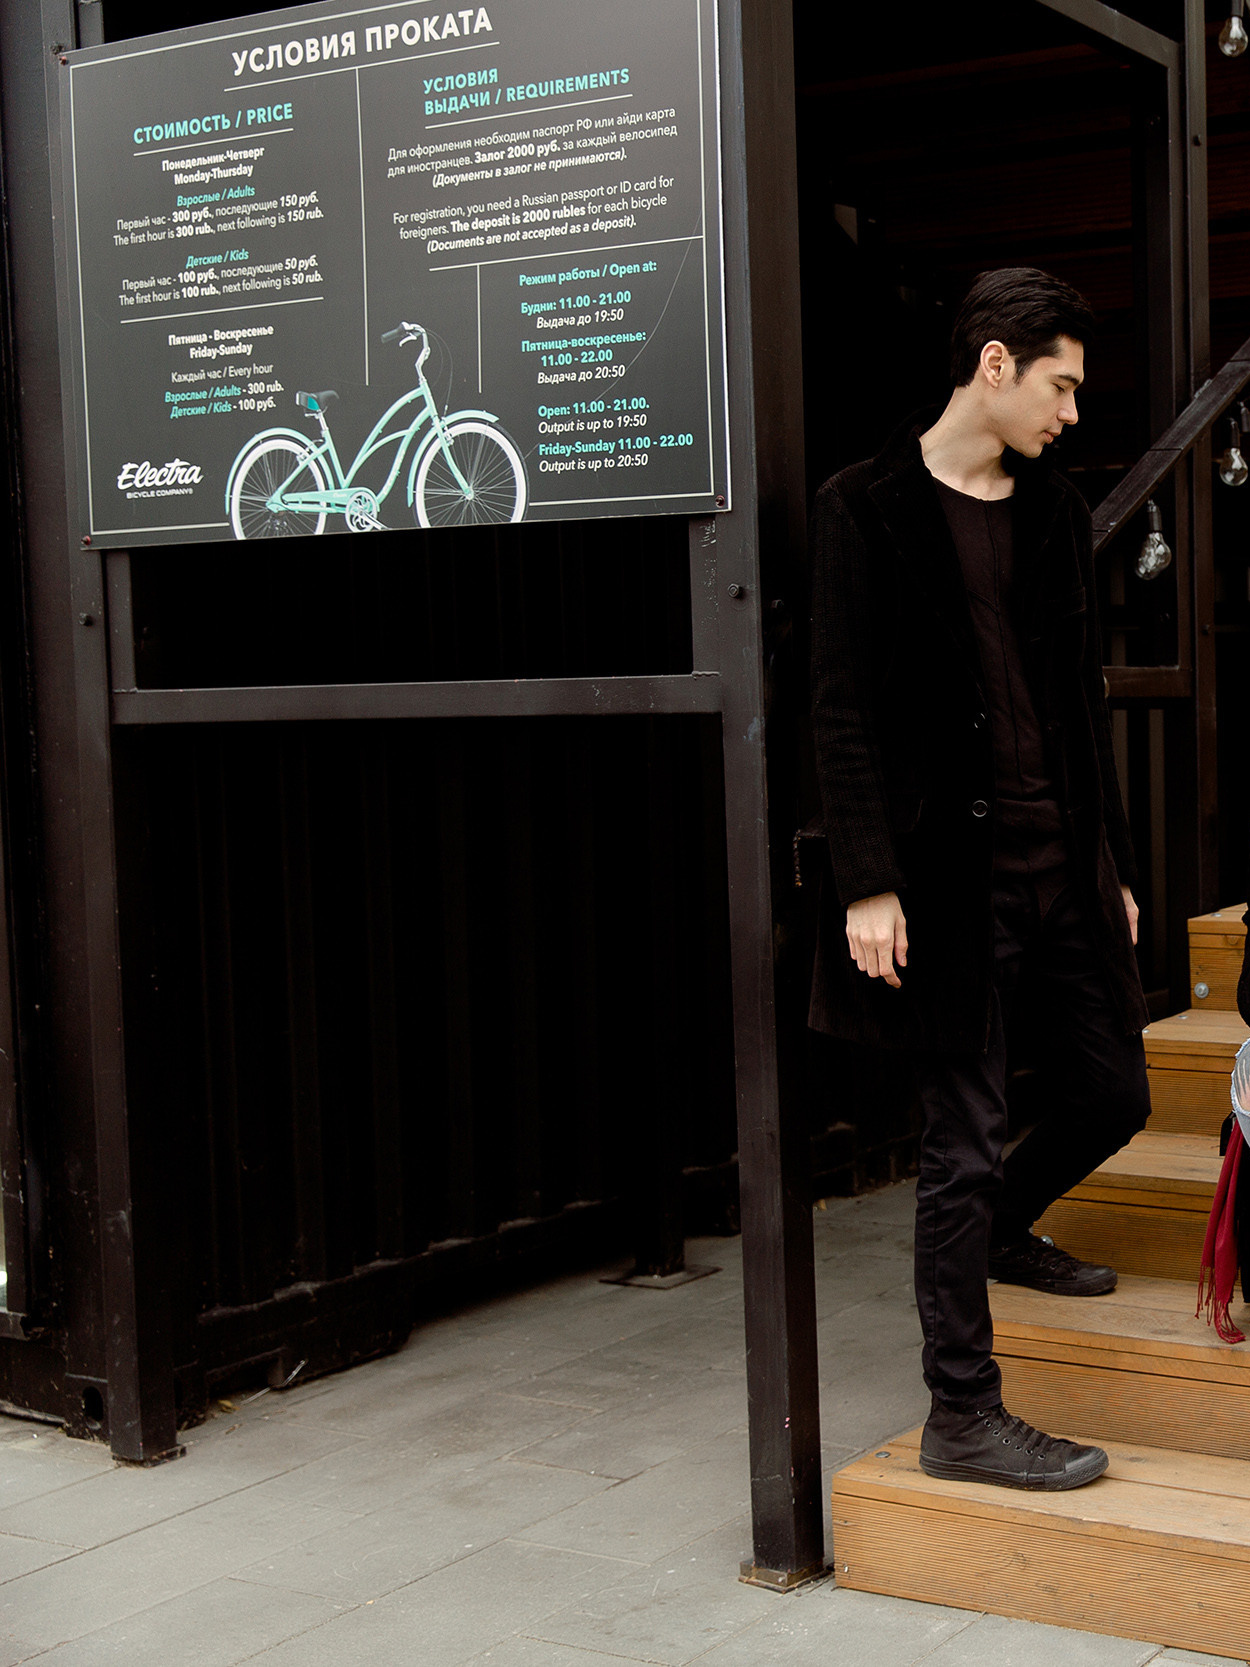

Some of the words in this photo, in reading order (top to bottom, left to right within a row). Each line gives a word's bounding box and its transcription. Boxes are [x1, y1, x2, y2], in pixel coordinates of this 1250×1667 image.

[231, 30, 356, 76] УСЛОВИЯ
[365, 7, 492, 52] ПРОКАТА
[423, 68, 498, 94] УСЛОВИЯ
[424, 91, 490, 115] ВЫДАЧИ
[495, 88, 501, 104] /
[506, 68, 629, 102] REQUIREMENTS
[133, 113, 230, 144] СТОИМОСТЬ
[235, 110, 242, 128] /
[246, 102, 293, 125] PRICE
[387, 148, 407, 162] Для
[409, 139, 472, 158] оформления
[474, 130, 530, 147] необходим
[532, 123, 574, 138] паспорт
[576, 118, 592, 131] РФ
[594, 117, 614, 128] или
[616, 112, 643, 125] айди
[645, 108, 675, 122] карта
[161, 147, 264, 171] Понедельник-Четверг
[387, 166, 405, 178] для
[407, 156, 473, 173] иностранцев.
[474, 150, 506, 163] Залог
[507, 143, 535, 158] 2000
[536, 139, 560, 157] руб.
[562, 140, 574, 150] за
[576, 131, 616, 148] каждый
[619, 125, 678, 142] велосипед
[174, 163, 253, 185] Monday-Thursday
[432, 169, 493, 188] (Документы
[495, 168, 502, 177] в
[503, 163, 532, 176] залог
[533, 161, 547, 171] не
[548, 146, 627, 172] принимаются).
[176, 192, 220, 208] Взрослые
[226, 184, 255, 199] Adults
[393, 212, 409, 224] For
[410, 205, 465, 224] registration,
[466, 204, 484, 217] you
[486, 196, 512, 211] need
[513, 198, 520, 208] a
[522, 192, 558, 206] Russian
[560, 185, 604, 204] passport
[606, 185, 618, 195] or
[620, 180, 632, 193] ID
[633, 176, 656, 191] card
[658, 174, 674, 188] for
[116, 216, 150, 232] Первый
[151, 216, 166, 225] час
[172, 209, 190, 223] 300
[215, 200, 278, 216] последующие
[280, 193, 298, 207] 150
[298, 190, 319, 208] руб.
[399, 225, 449, 240] foreigners.
[450, 219, 470, 232] The
[471, 213, 510, 232] deposit
[511, 212, 521, 224] is
[522, 208, 550, 223] 2000
[552, 204, 586, 219] rubles
[587, 201, 602, 214] for
[604, 197, 628, 212] each
[630, 193, 667, 210] bicycle
[113, 234, 129, 246] The
[130, 232, 146, 243] first
[146, 230, 166, 241] hour
[167, 228, 174, 238] is
[175, 224, 194, 238] 300
[217, 220, 236, 232] next
[236, 214, 276, 229] following
[278, 212, 285, 223] is
[287, 208, 305, 222] 150
[306, 206, 324, 219] rub.
[427, 235, 484, 254] (Documents
[485, 234, 502, 244] are
[503, 230, 520, 242] not
[521, 222, 568, 240] accepted
[569, 224, 581, 234] as
[582, 223, 589, 232] a
[591, 214, 636, 233] deposit).
[185, 254, 223, 269] Детские
[229, 248, 249, 261] Kids
[122, 276, 155, 292] Первый
[156, 276, 172, 286] час
[177, 270, 196, 283] 100
[220, 262, 283, 278] последующие
[284, 257, 297, 270] 50
[297, 254, 318, 271] руб.
[519, 273, 556, 286] Режим
[558, 267, 600, 285] работы
[609, 263, 640, 278] Open
[642, 260, 657, 272] at:
[118, 294, 134, 305] The
[135, 292, 151, 304] first
[152, 291, 172, 302] hour
[173, 289, 180, 299] is
[181, 285, 199, 298] 100
[222, 282, 241, 293] next
[241, 277, 281, 291] following
[283, 275, 290, 286] is
[291, 272, 304, 285] 50
[305, 270, 323, 283] rub.
[521, 301, 556, 316] Будни:
[558, 294, 590, 309] 11.00
[598, 290, 631, 305] 21.00
[536, 316, 575, 329] Выдача
[576, 314, 591, 326] до
[594, 308, 624, 322] 19:50
[168, 333, 208, 346] Пятница
[213, 326, 274, 341] Воскресенье
[521, 331, 646, 352] Пятница-воскресенье:
[189, 341, 253, 359] Friday-Sunday
[540, 352, 572, 367] 11.00
[580, 348, 612, 363] 22.00
[171, 369, 206, 383] Каждый
[206, 370, 222, 379] час
[228, 365, 252, 378] Every
[252, 363, 273, 374] hour
[537, 372, 576, 384] Выдача
[578, 370, 593, 382] до
[594, 364, 625, 379] 20:50
[164, 390, 208, 404] Взрослые
[213, 384, 241, 398] Adults
[247, 381, 265, 394] 300
[266, 380, 284, 392] rub.
[170, 406, 206, 419] Детские
[213, 400, 232, 413] Kids
[238, 398, 255, 410] 100
[256, 396, 276, 412] руб.
[538, 405, 570, 419] Open:
[572, 400, 605, 414] 11.00
[613, 397, 650, 411] 21.00.
[538, 420, 575, 435] Output
[576, 419, 585, 431] is
[586, 420, 601, 433] up
[602, 418, 614, 428] to
[617, 413, 647, 427] 19:50
[538, 439, 616, 457] Friday-Sunday
[618, 436, 650, 450] 11.00
[659, 433, 693, 447] 22.00
[117, 457, 204, 491] Electra
[539, 459, 576, 474] Output
[577, 458, 586, 470] is
[587, 459, 602, 472] up
[603, 457, 615, 468] to
[617, 453, 648, 467] 20:50
[126, 490, 155, 499] BICYCLE
